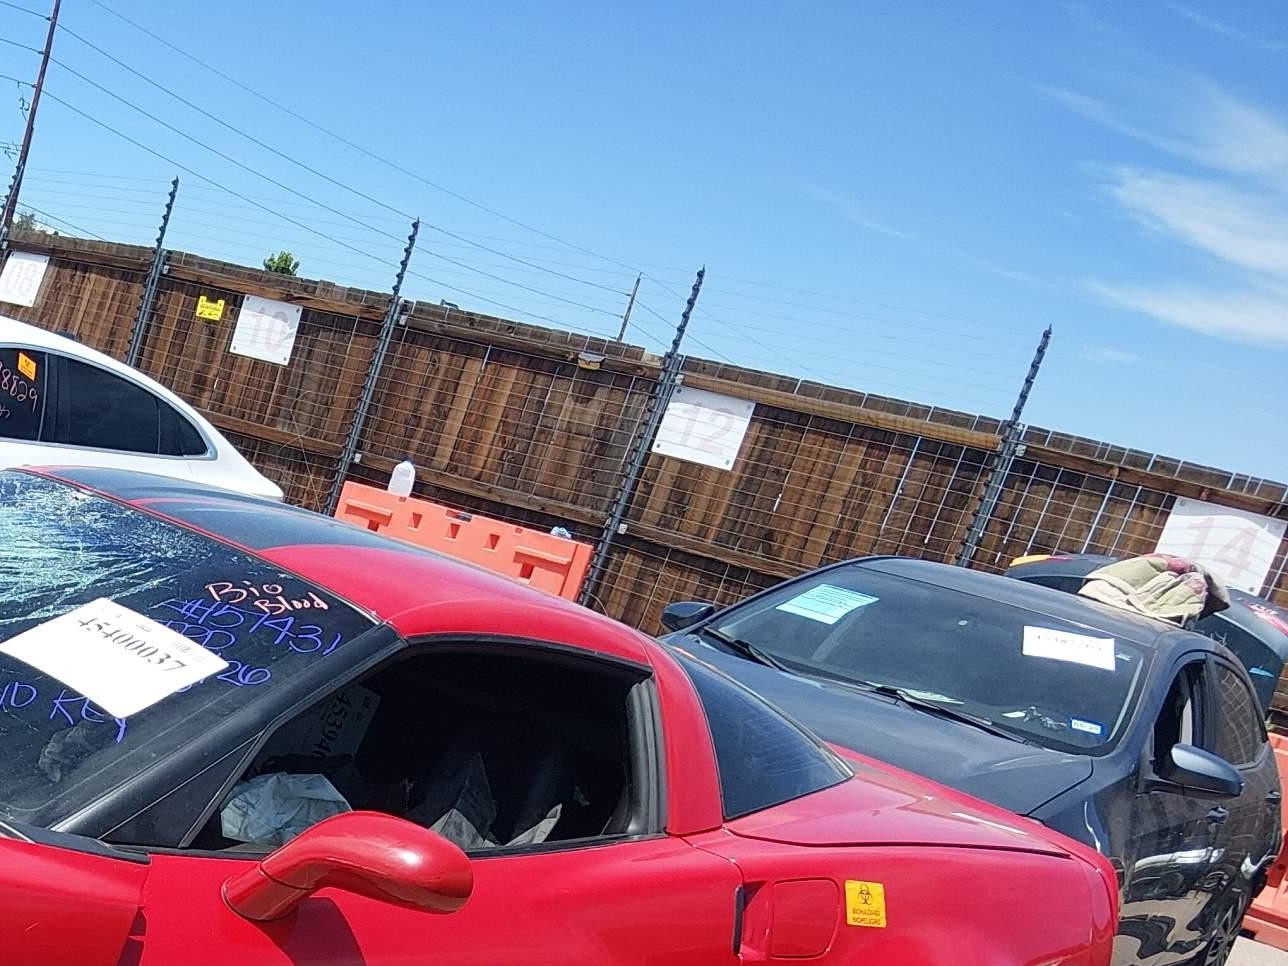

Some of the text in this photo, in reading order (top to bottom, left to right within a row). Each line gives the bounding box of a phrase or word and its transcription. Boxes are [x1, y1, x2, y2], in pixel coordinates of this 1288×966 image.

[251, 307, 289, 353] 10
[679, 402, 735, 457] 12
[1186, 516, 1260, 580] 14
[205, 580, 283, 604] Bio
[253, 592, 329, 615] Blood
[78, 617, 188, 672] 45400037
[49, 688, 128, 744] KEY
